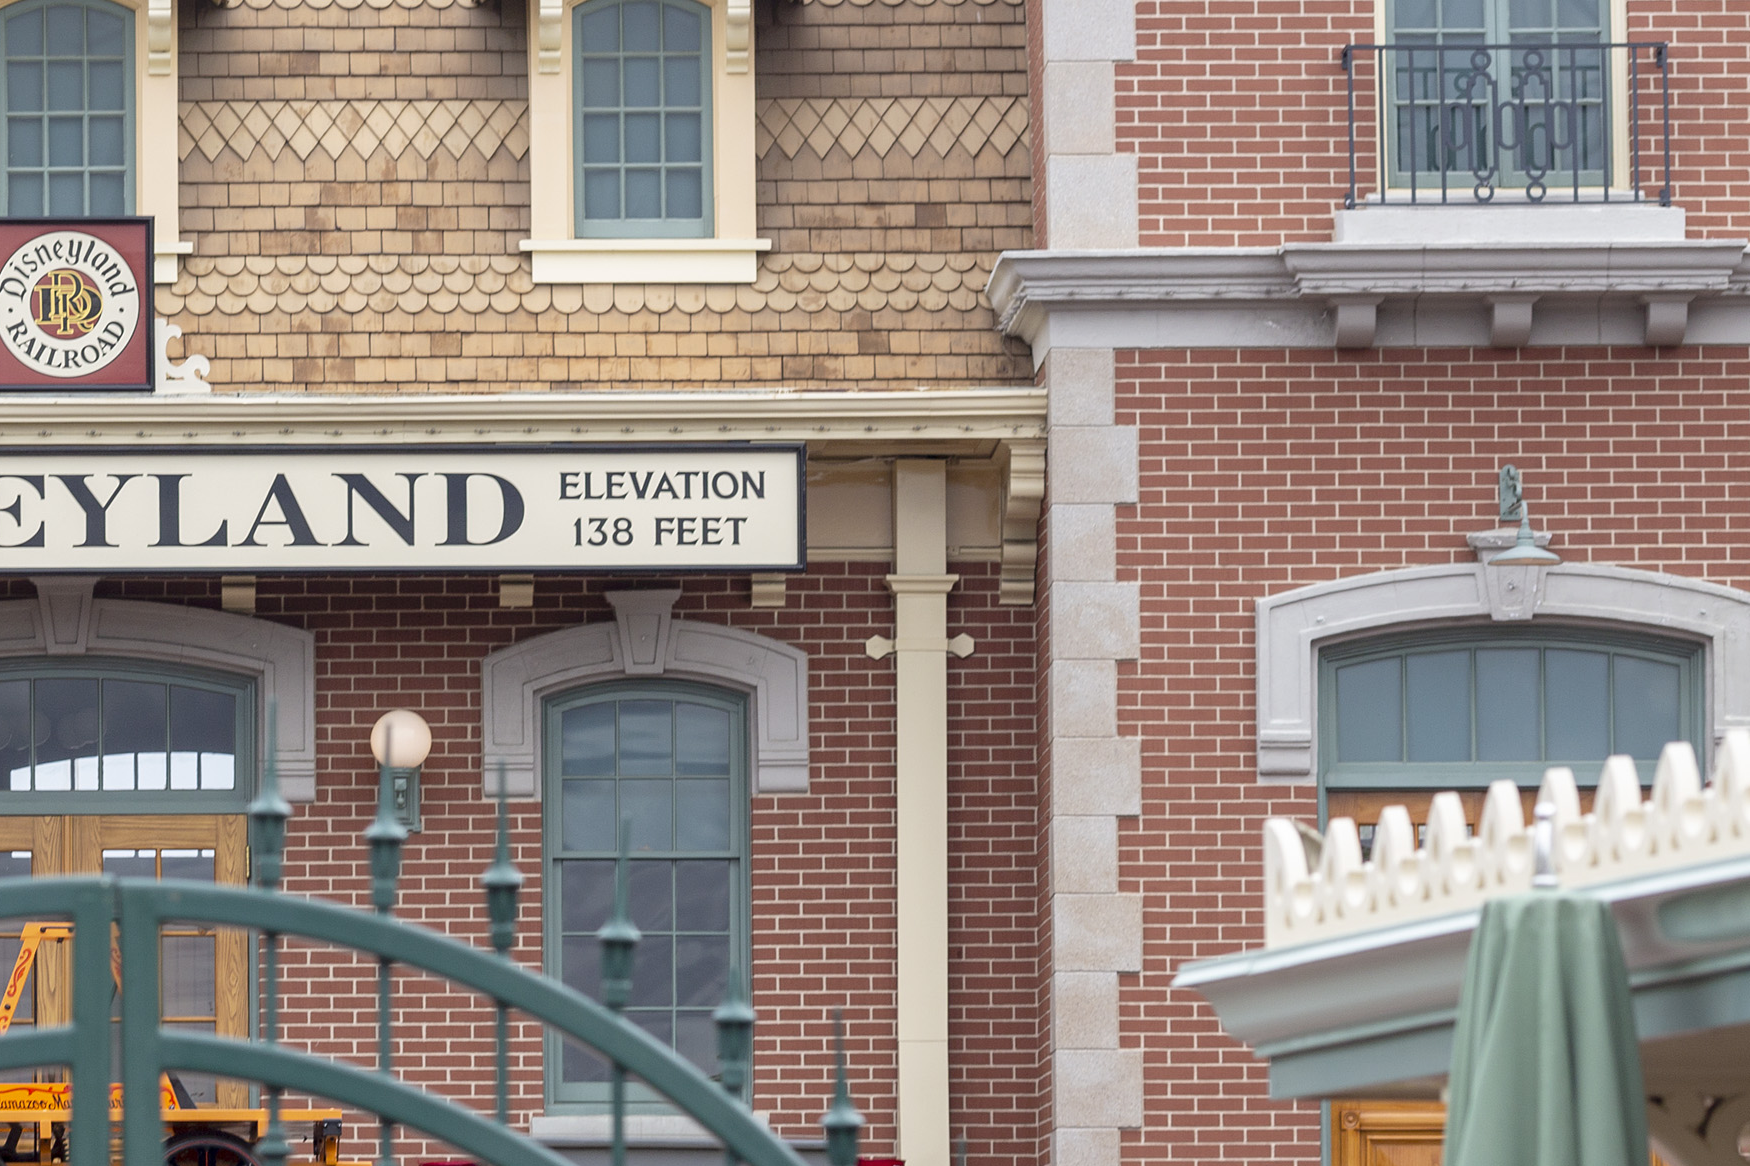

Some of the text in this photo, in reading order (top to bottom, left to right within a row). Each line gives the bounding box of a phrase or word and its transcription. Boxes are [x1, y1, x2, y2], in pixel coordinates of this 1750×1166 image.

[6, 320, 124, 368] RAILROAD
[559, 471, 765, 500] ELEVATION
[574, 517, 748, 547] 138 FEET
